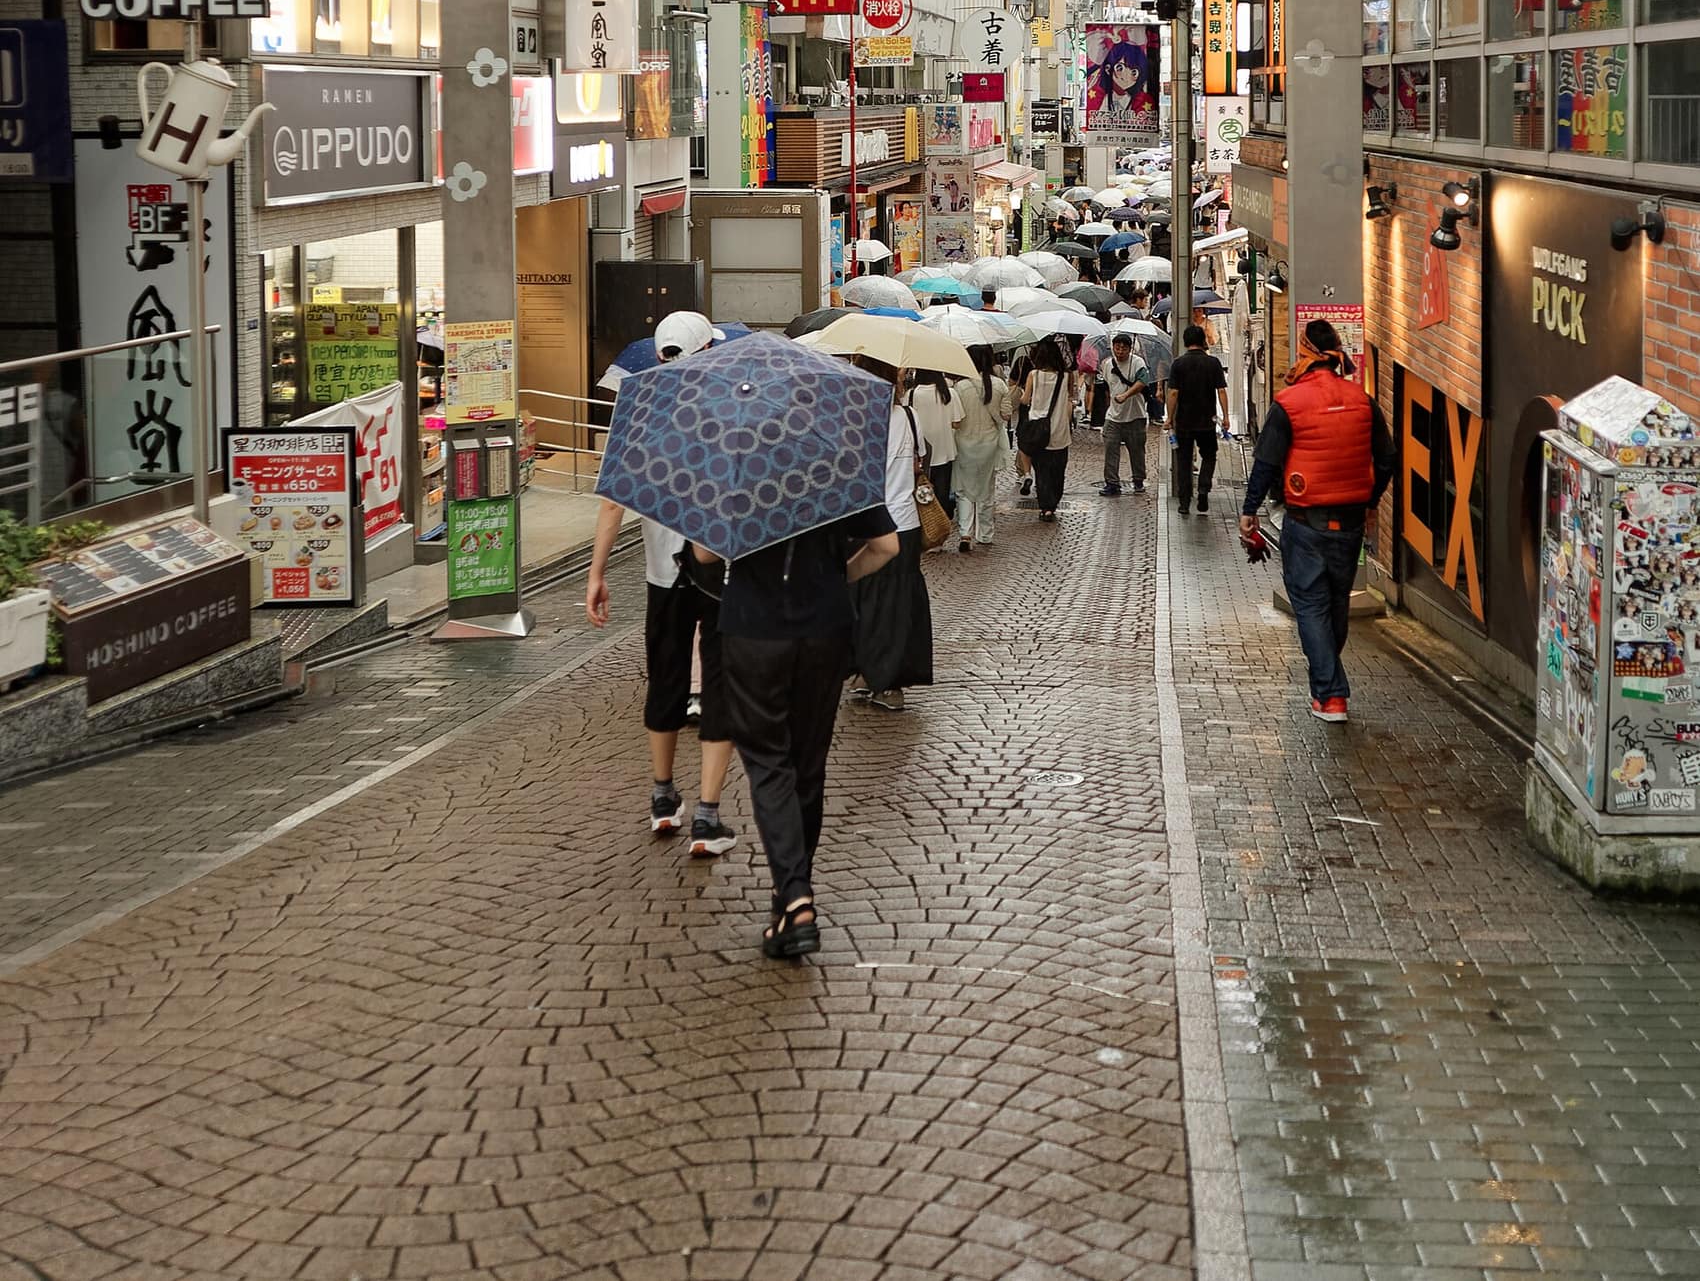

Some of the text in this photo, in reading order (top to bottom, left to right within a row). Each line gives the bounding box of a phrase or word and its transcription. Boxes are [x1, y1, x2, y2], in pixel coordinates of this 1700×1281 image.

[865, 0, 900, 16] 消火栓
[591, 1, 614, 68] 一風堂
[980, 12, 1005, 65] 古着
[1209, 2, 1222, 52] 吉野家
[322, 89, 373, 103] RAMEN
[148, 102, 208, 164] H
[301, 125, 412, 171] IPPUDO
[1210, 148, 1241, 160] 吉茶
[140, 206, 171, 232] BF
[1532, 246, 1587, 282] WOLFGANG
[1532, 276, 1587, 344] PUCK
[447, 329, 484, 337] TAKESHITA
[232, 437, 319, 453] 星乃珈琲店
[323, 436, 344, 446] BF
[241, 465, 337, 478] モーニングサービス
[380, 455, 398, 492] B1
[86, 595, 237, 670] HOSHINO COFFEE
